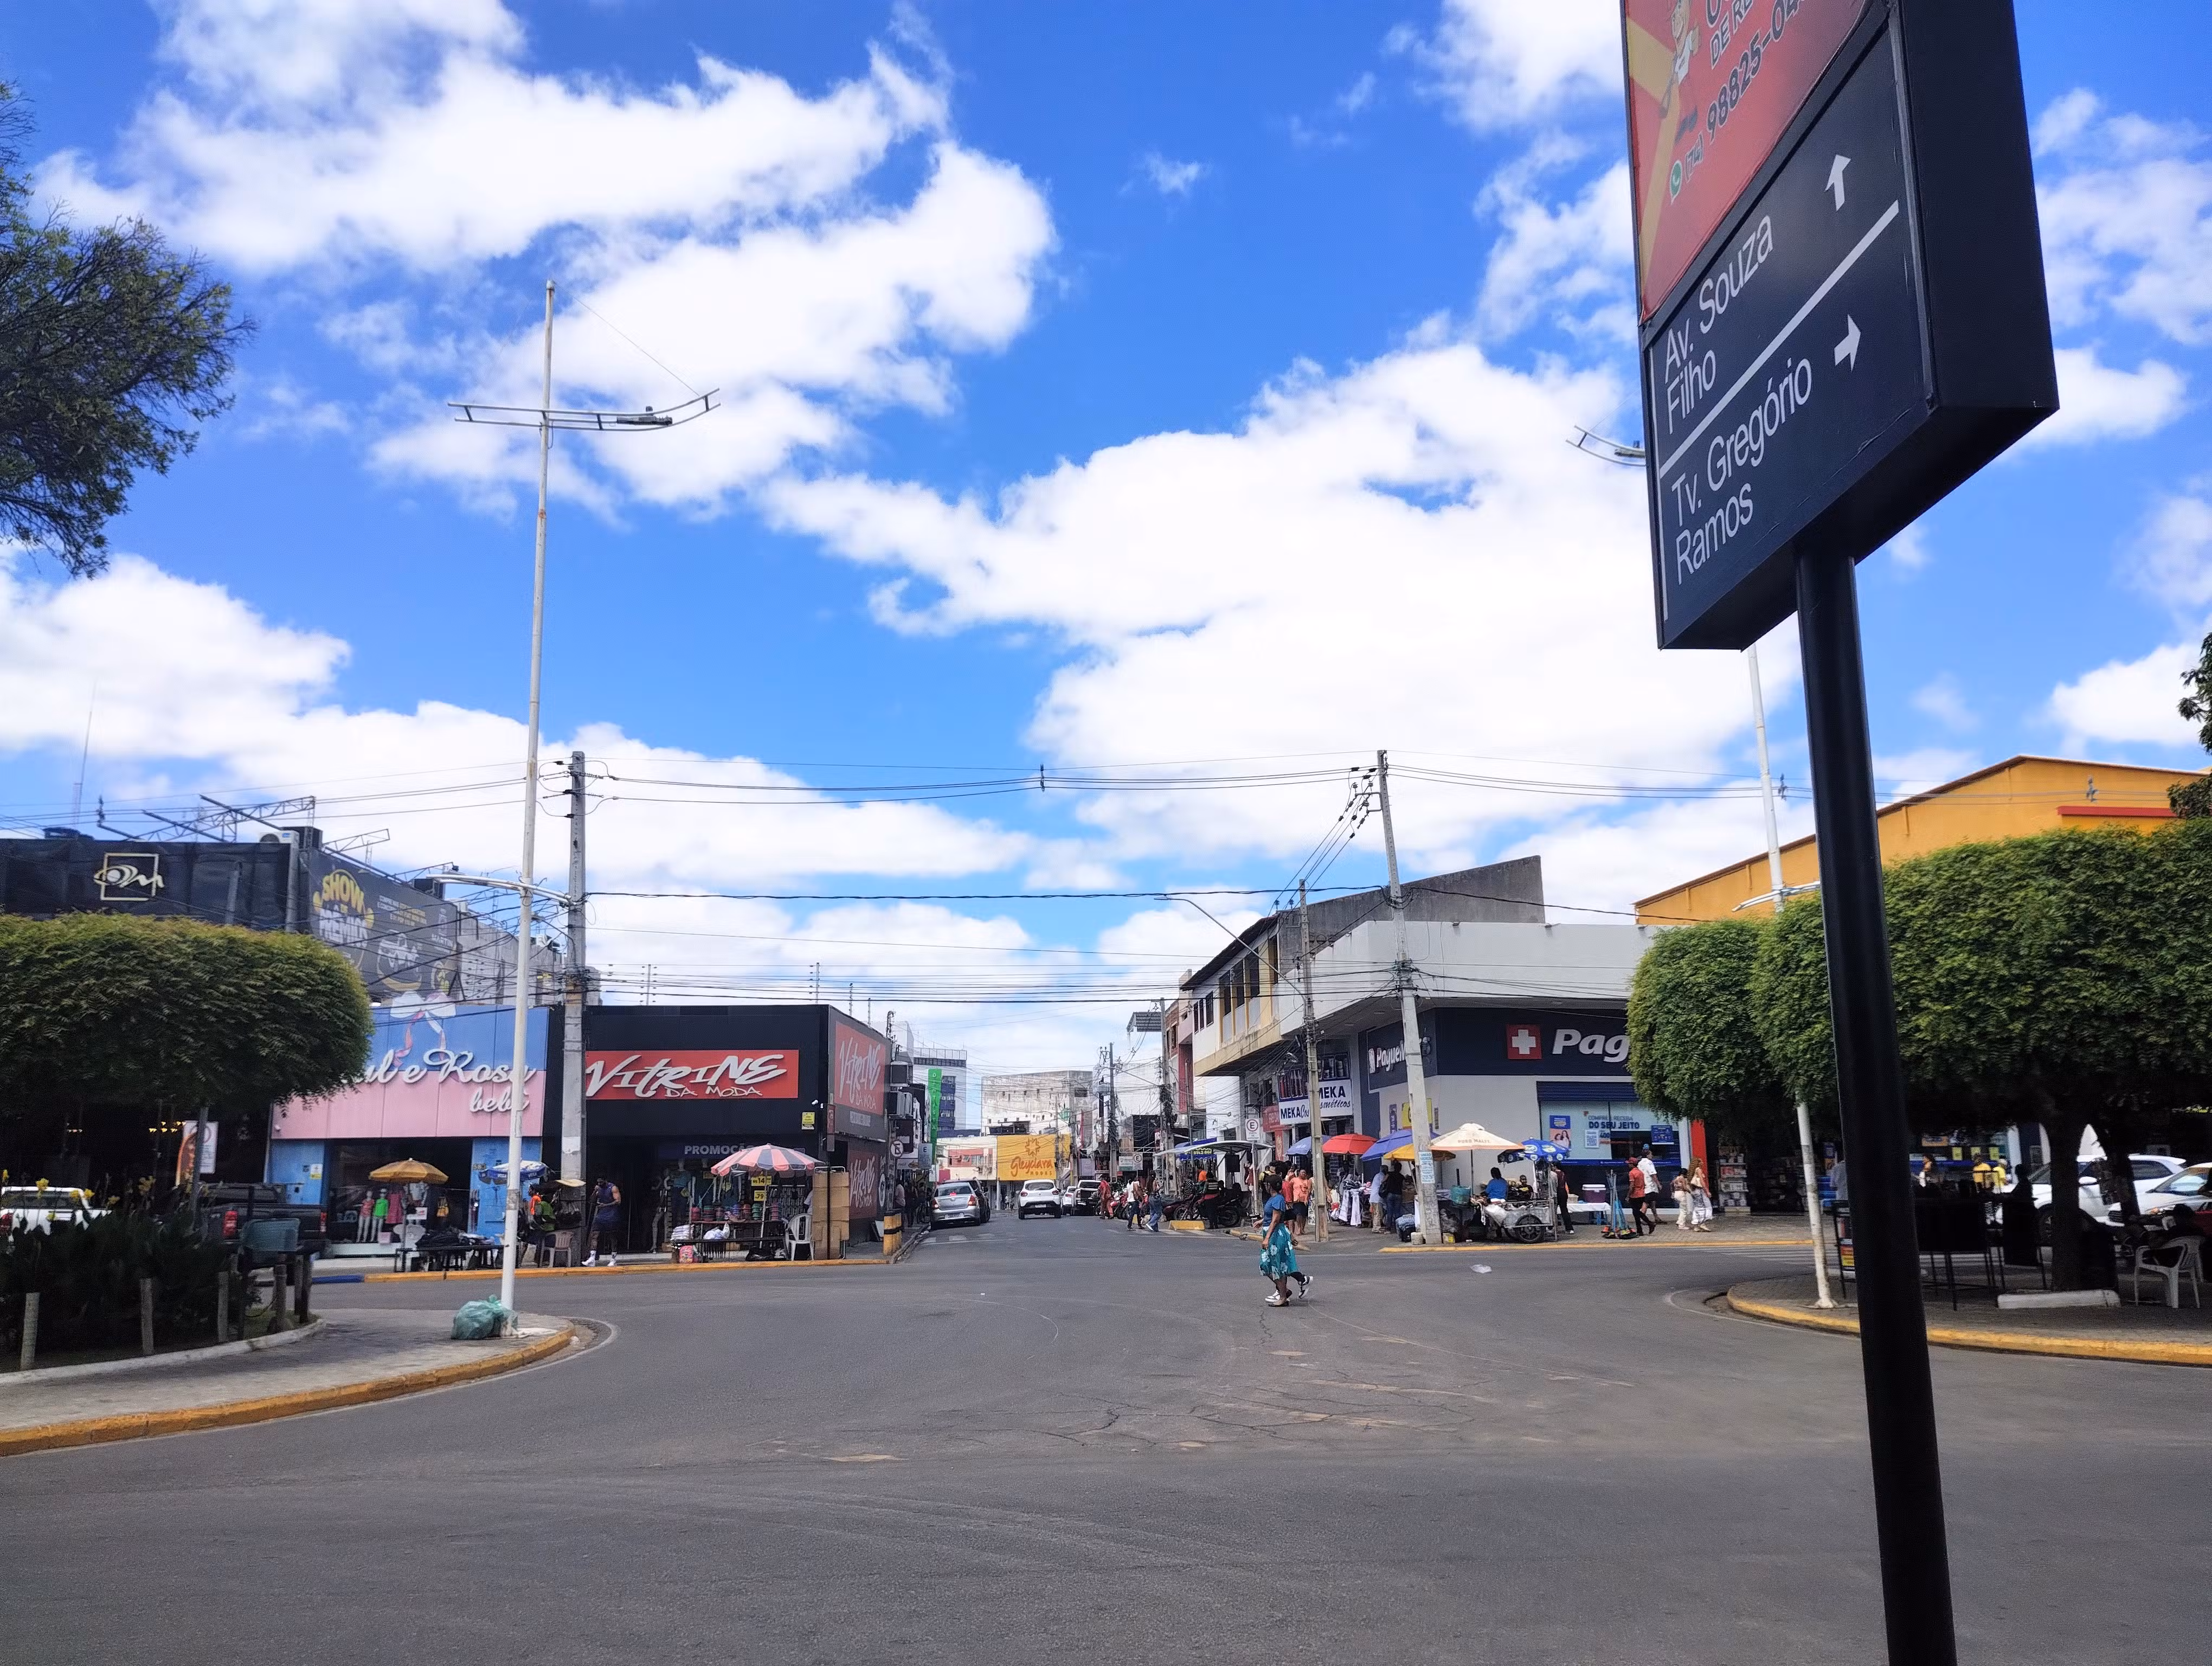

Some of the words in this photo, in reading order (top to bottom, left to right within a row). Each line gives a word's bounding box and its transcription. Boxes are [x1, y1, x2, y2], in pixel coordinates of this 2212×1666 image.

[1665, 318, 1694, 384] Av.
[1699, 215, 1773, 334] Souza
[1667, 350, 1716, 435] Filho
[1671, 472, 1702, 527] Tv.
[1707, 357, 1812, 492] Gregório
[1676, 483, 1753, 585] Ramos
[322, 873, 364, 913] SHOW
[665, 1086, 698, 1097] DA
[705, 1086, 763, 1097] MODA
[1281, 1106, 1301, 1119] MEKA
